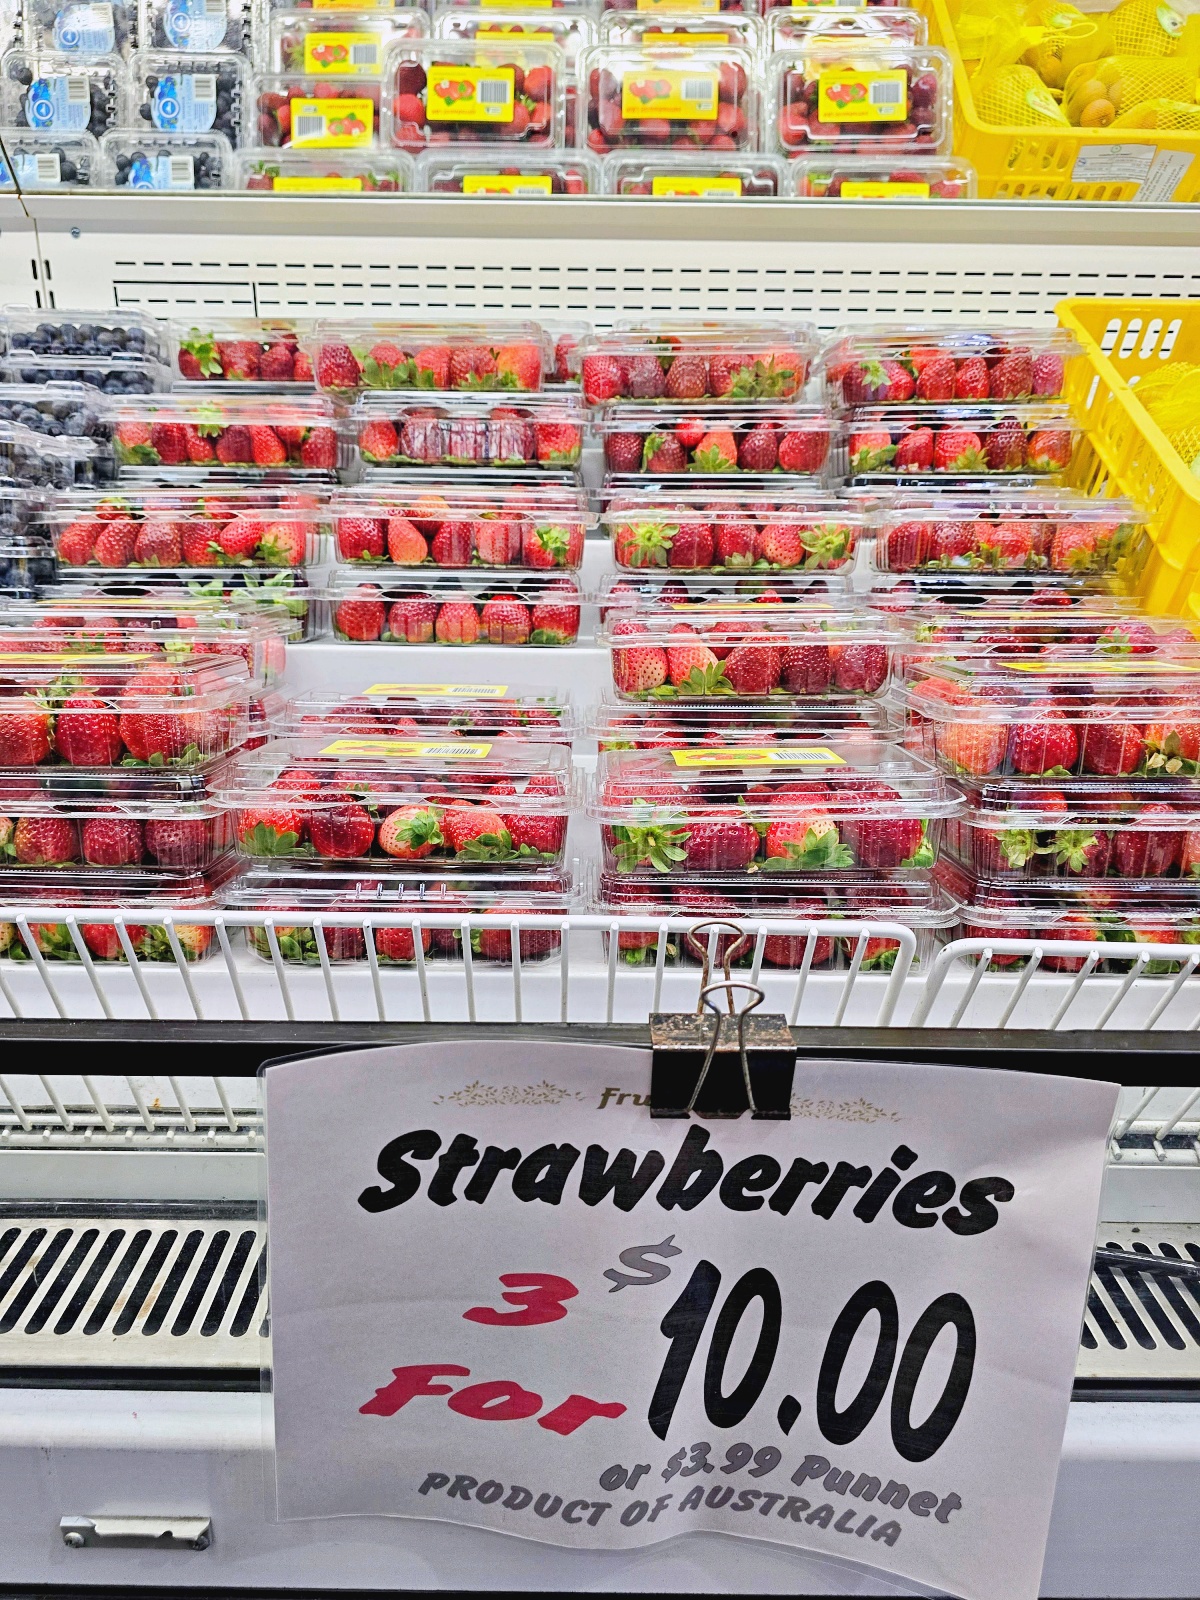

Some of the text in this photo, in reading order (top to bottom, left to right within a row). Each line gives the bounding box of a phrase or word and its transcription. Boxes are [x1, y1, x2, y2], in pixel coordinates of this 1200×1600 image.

[356, 1123, 1015, 1237] Strawberries
[461, 1272, 580, 1327] 3
[358, 1363, 628, 1438] For
[417, 1472, 903, 1548] PRODUCT OF AUSTRALIA
[598, 1441, 963, 1525] or $3.99 Punnet
